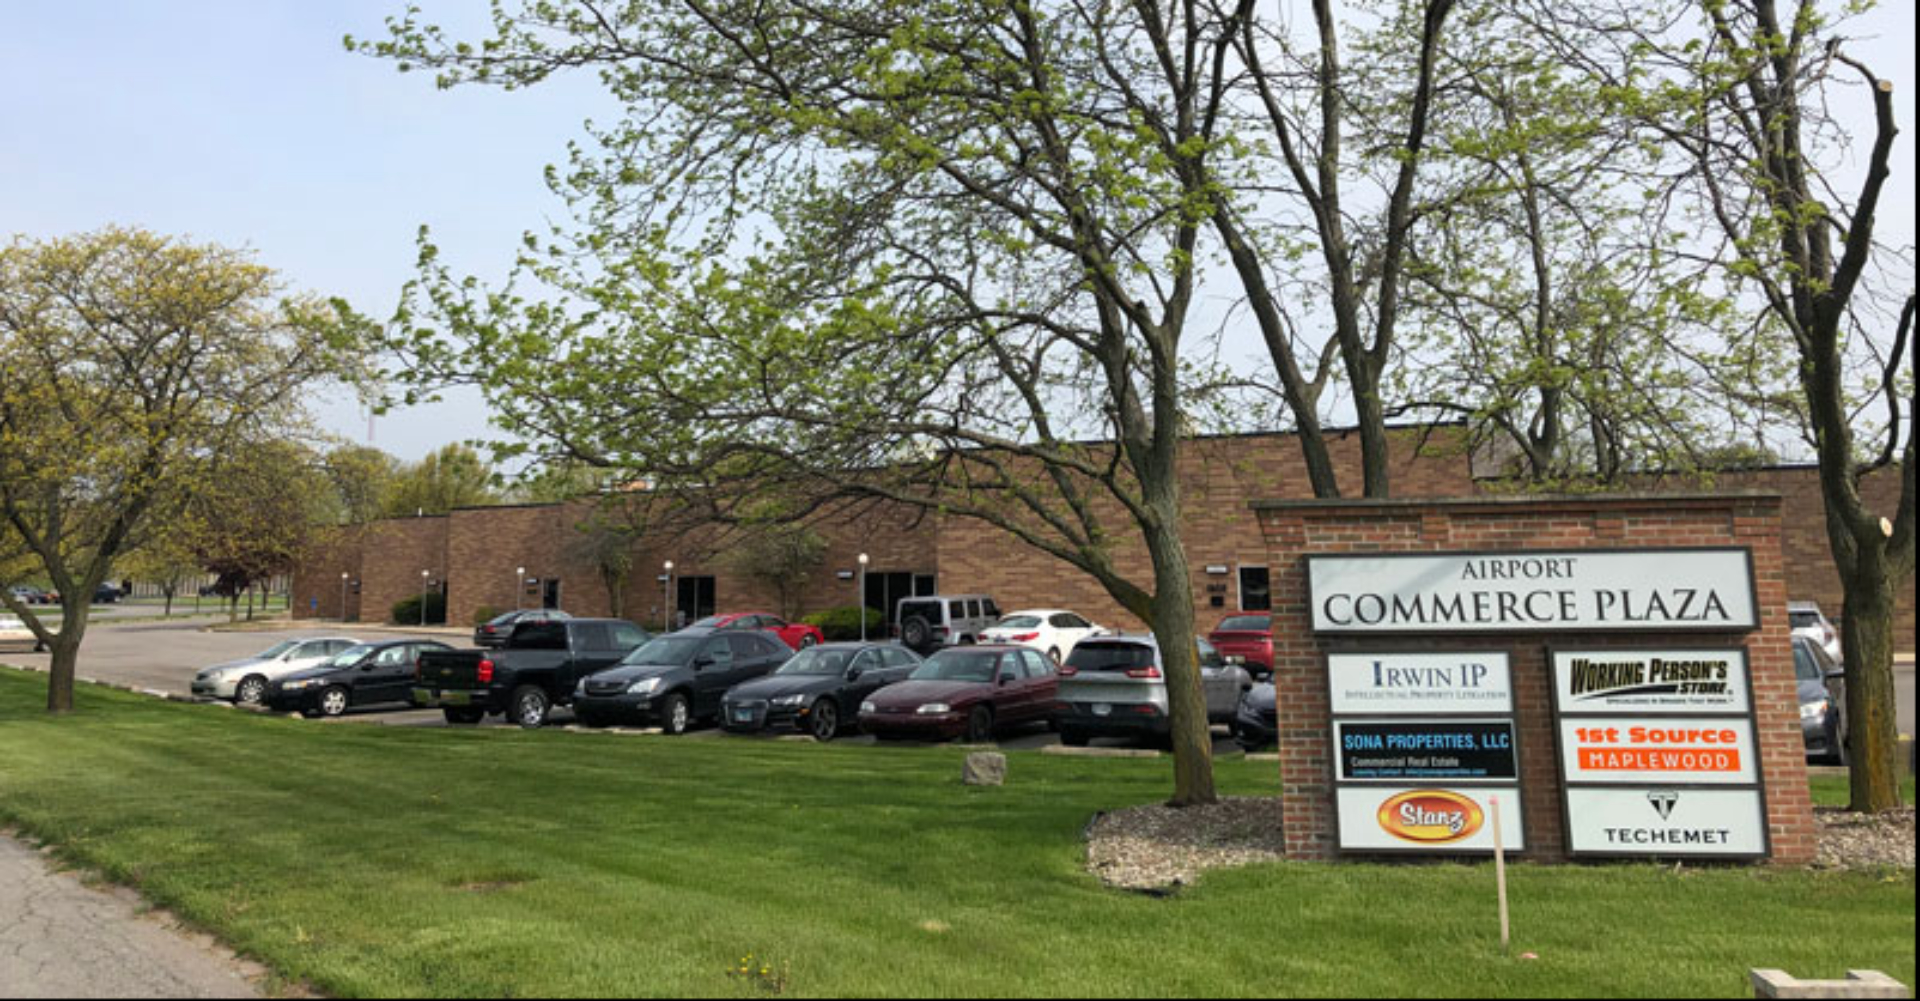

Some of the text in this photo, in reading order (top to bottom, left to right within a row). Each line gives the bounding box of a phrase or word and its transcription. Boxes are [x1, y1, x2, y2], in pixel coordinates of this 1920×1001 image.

[1461, 558, 1577, 580] AIRPORT
[1322, 588, 1731, 626] COMMERCE PLAZA
[1373, 660, 1488, 687] IRWIN IP
[1570, 657, 1728, 695] WORKING PERSON'S
[1345, 733, 1509, 751] SONA PROPERTIES, LLC
[1575, 726, 1737, 743] 1st Source
[1352, 756, 1460, 767] Commercial Real Estate
[1588, 752, 1730, 769] MAPLEWOOD
[1399, 801, 1465, 834] Stanz
[1604, 828, 1730, 844] TECHEMET
